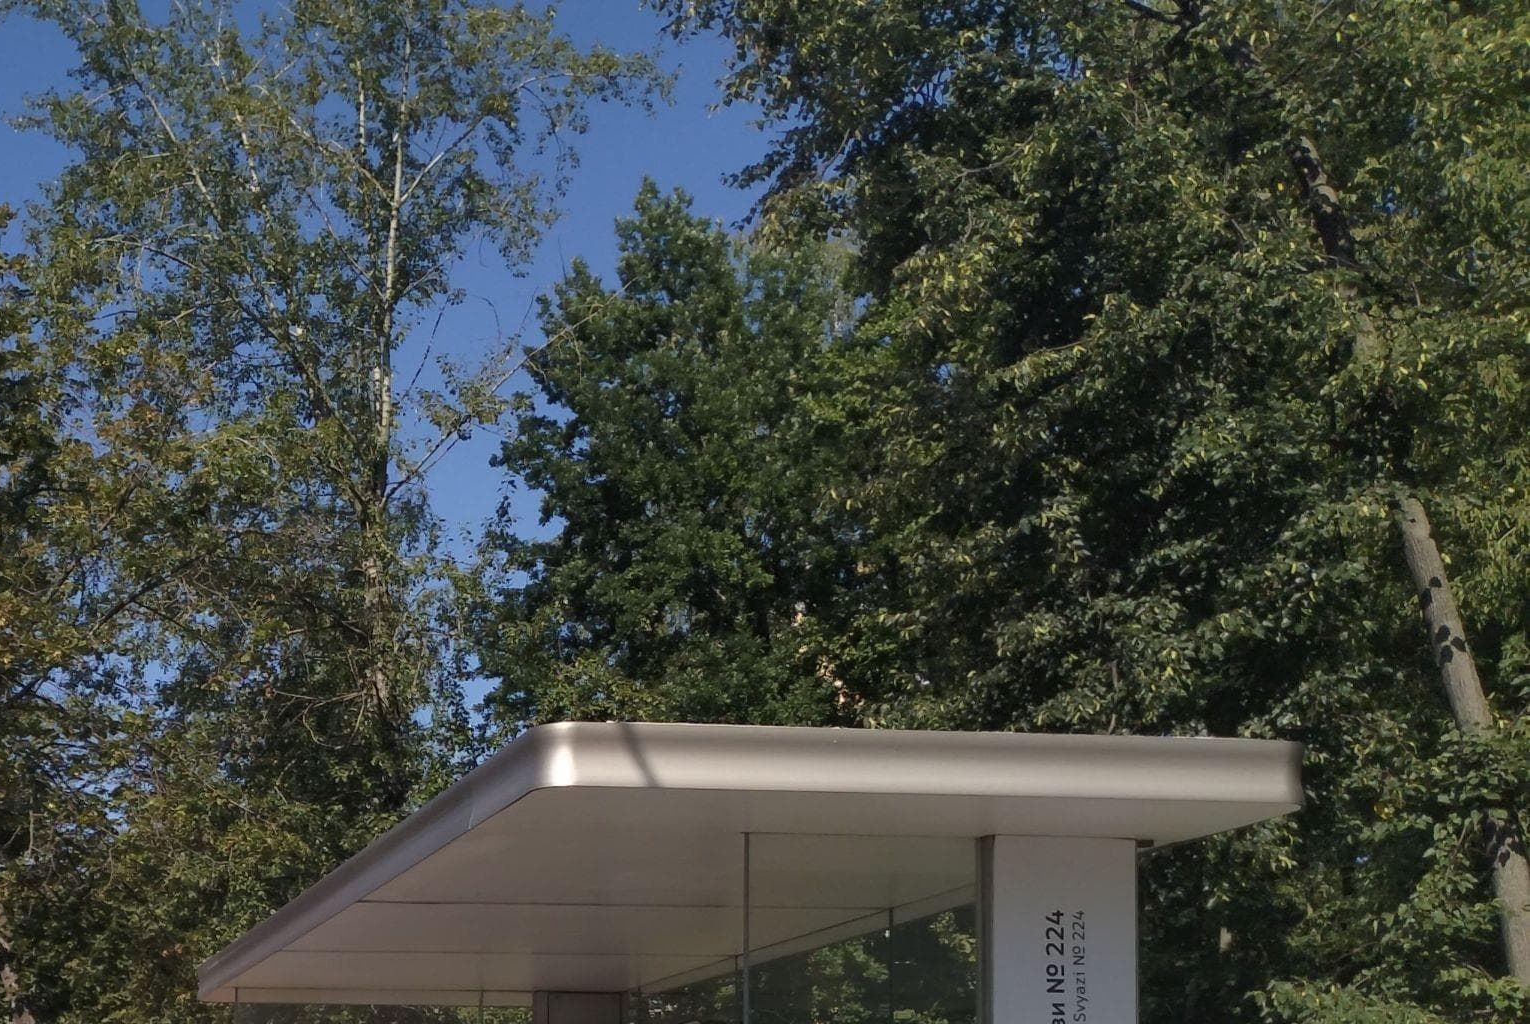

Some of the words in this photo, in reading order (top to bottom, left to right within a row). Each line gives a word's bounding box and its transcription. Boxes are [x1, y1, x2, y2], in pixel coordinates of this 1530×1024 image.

[1046, 910, 1064, 956] 224
[1072, 910, 1085, 940] 224
[1046, 964, 1065, 994] №
[1073, 972, 1089, 1022] Svyazi
